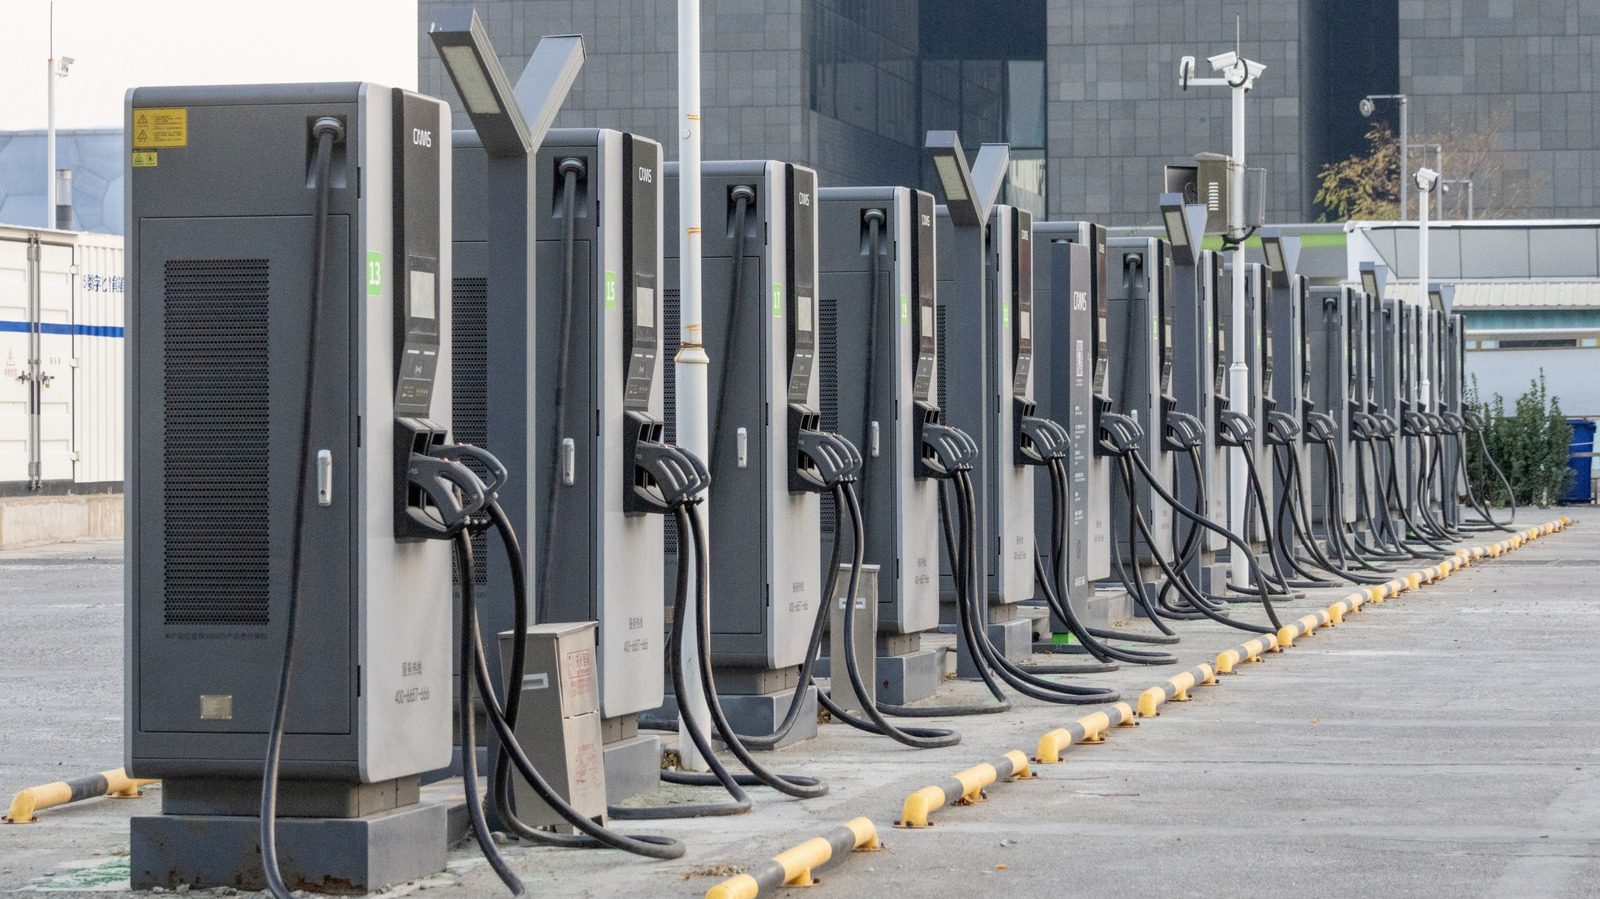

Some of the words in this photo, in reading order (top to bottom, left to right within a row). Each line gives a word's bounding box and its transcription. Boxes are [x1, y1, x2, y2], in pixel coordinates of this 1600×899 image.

[369, 261, 381, 285] 13
[606, 281, 615, 301] 15
[773, 291, 781, 309] 17
